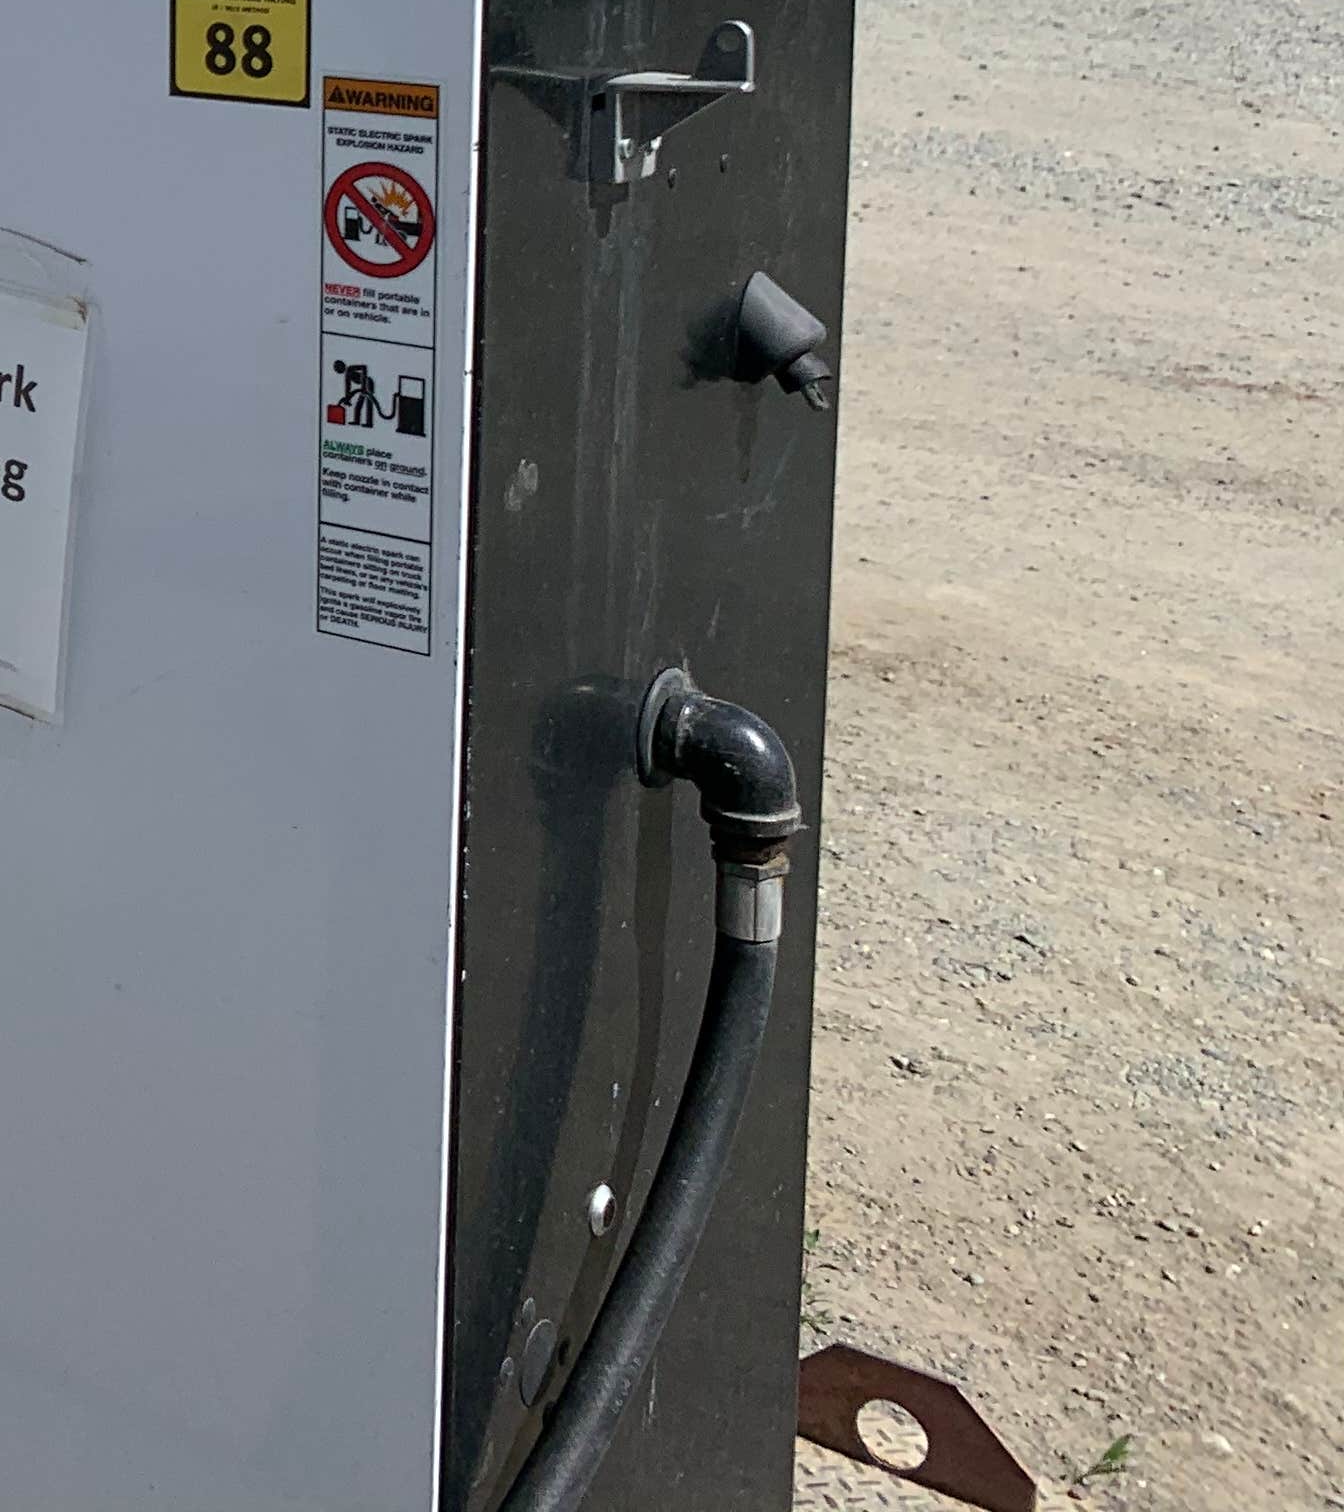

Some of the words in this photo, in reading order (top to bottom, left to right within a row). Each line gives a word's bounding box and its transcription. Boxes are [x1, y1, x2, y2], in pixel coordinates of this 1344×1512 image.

[205, 22, 273, 78] 88
[346, 89, 434, 113] WARNING
[328, 127, 356, 137] STATIC
[359, 129, 401, 141] ELECTRIC
[403, 133, 433, 144] SPARK
[336, 138, 385, 151] EXPLOSION
[387, 143, 424, 154] HAZARD
[325, 283, 360, 298] NEVER
[363, 288, 376, 298] fill
[378, 292, 420, 305] portable
[324, 296, 377, 310] containers
[379, 303, 399, 313] that
[401, 307, 418, 316] are
[337, 310, 350, 318] on
[323, 440, 364, 456] ALWAYS
[367, 448, 392, 460] place
[323, 451, 372, 466] containers
[322, 479, 342, 489] with
[344, 483, 389, 498] container
[391, 491, 416, 503] while
[323, 467, 347, 480] Keep
[349, 473, 379, 486] nozzle
[393, 481, 429, 495] contact
